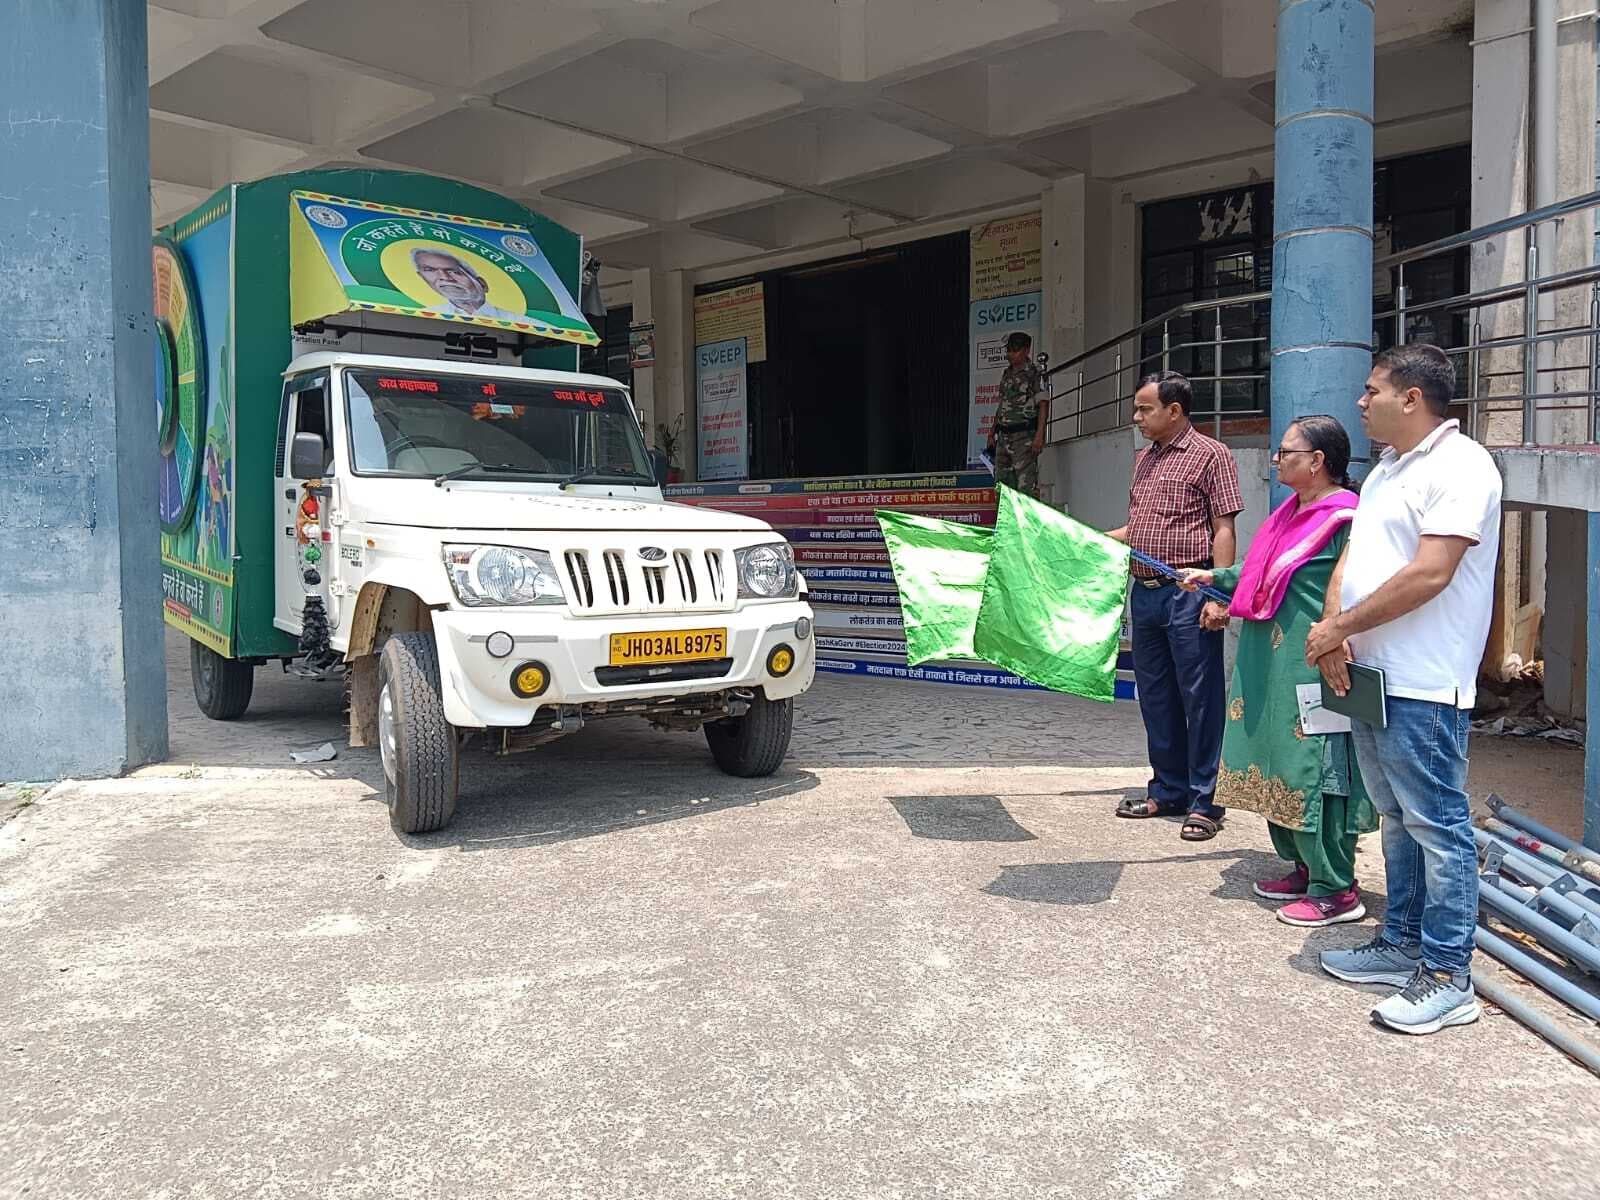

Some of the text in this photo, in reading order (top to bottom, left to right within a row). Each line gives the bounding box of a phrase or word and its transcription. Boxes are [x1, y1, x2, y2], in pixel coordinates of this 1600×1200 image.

[352, 237, 377, 251] जो
[366, 221, 409, 240] कहते
[430, 226, 452, 241] वो
[459, 237, 505, 262] करते
[977, 303, 1037, 326] SWEEP
[702, 348, 741, 367] SWEEP
[378, 379, 438, 392] जय महाकाल
[553, 390, 574, 401] जय
[808, 498, 820, 506] एक
[842, 496, 855, 504] एक
[895, 494, 908, 502] एक
[848, 614, 875, 625] लोकतंत्र
[876, 616, 886, 625] का
[623, 634, 723, 658] JH03AL8975
[855, 640, 906, 651] #Election2024
[866, 664, 893, 676] मतदान
[894, 667, 907, 676] एक
[948, 670, 954, 680] है
[956, 671, 982, 683] जिससे
[983, 675, 998, 684] हम
